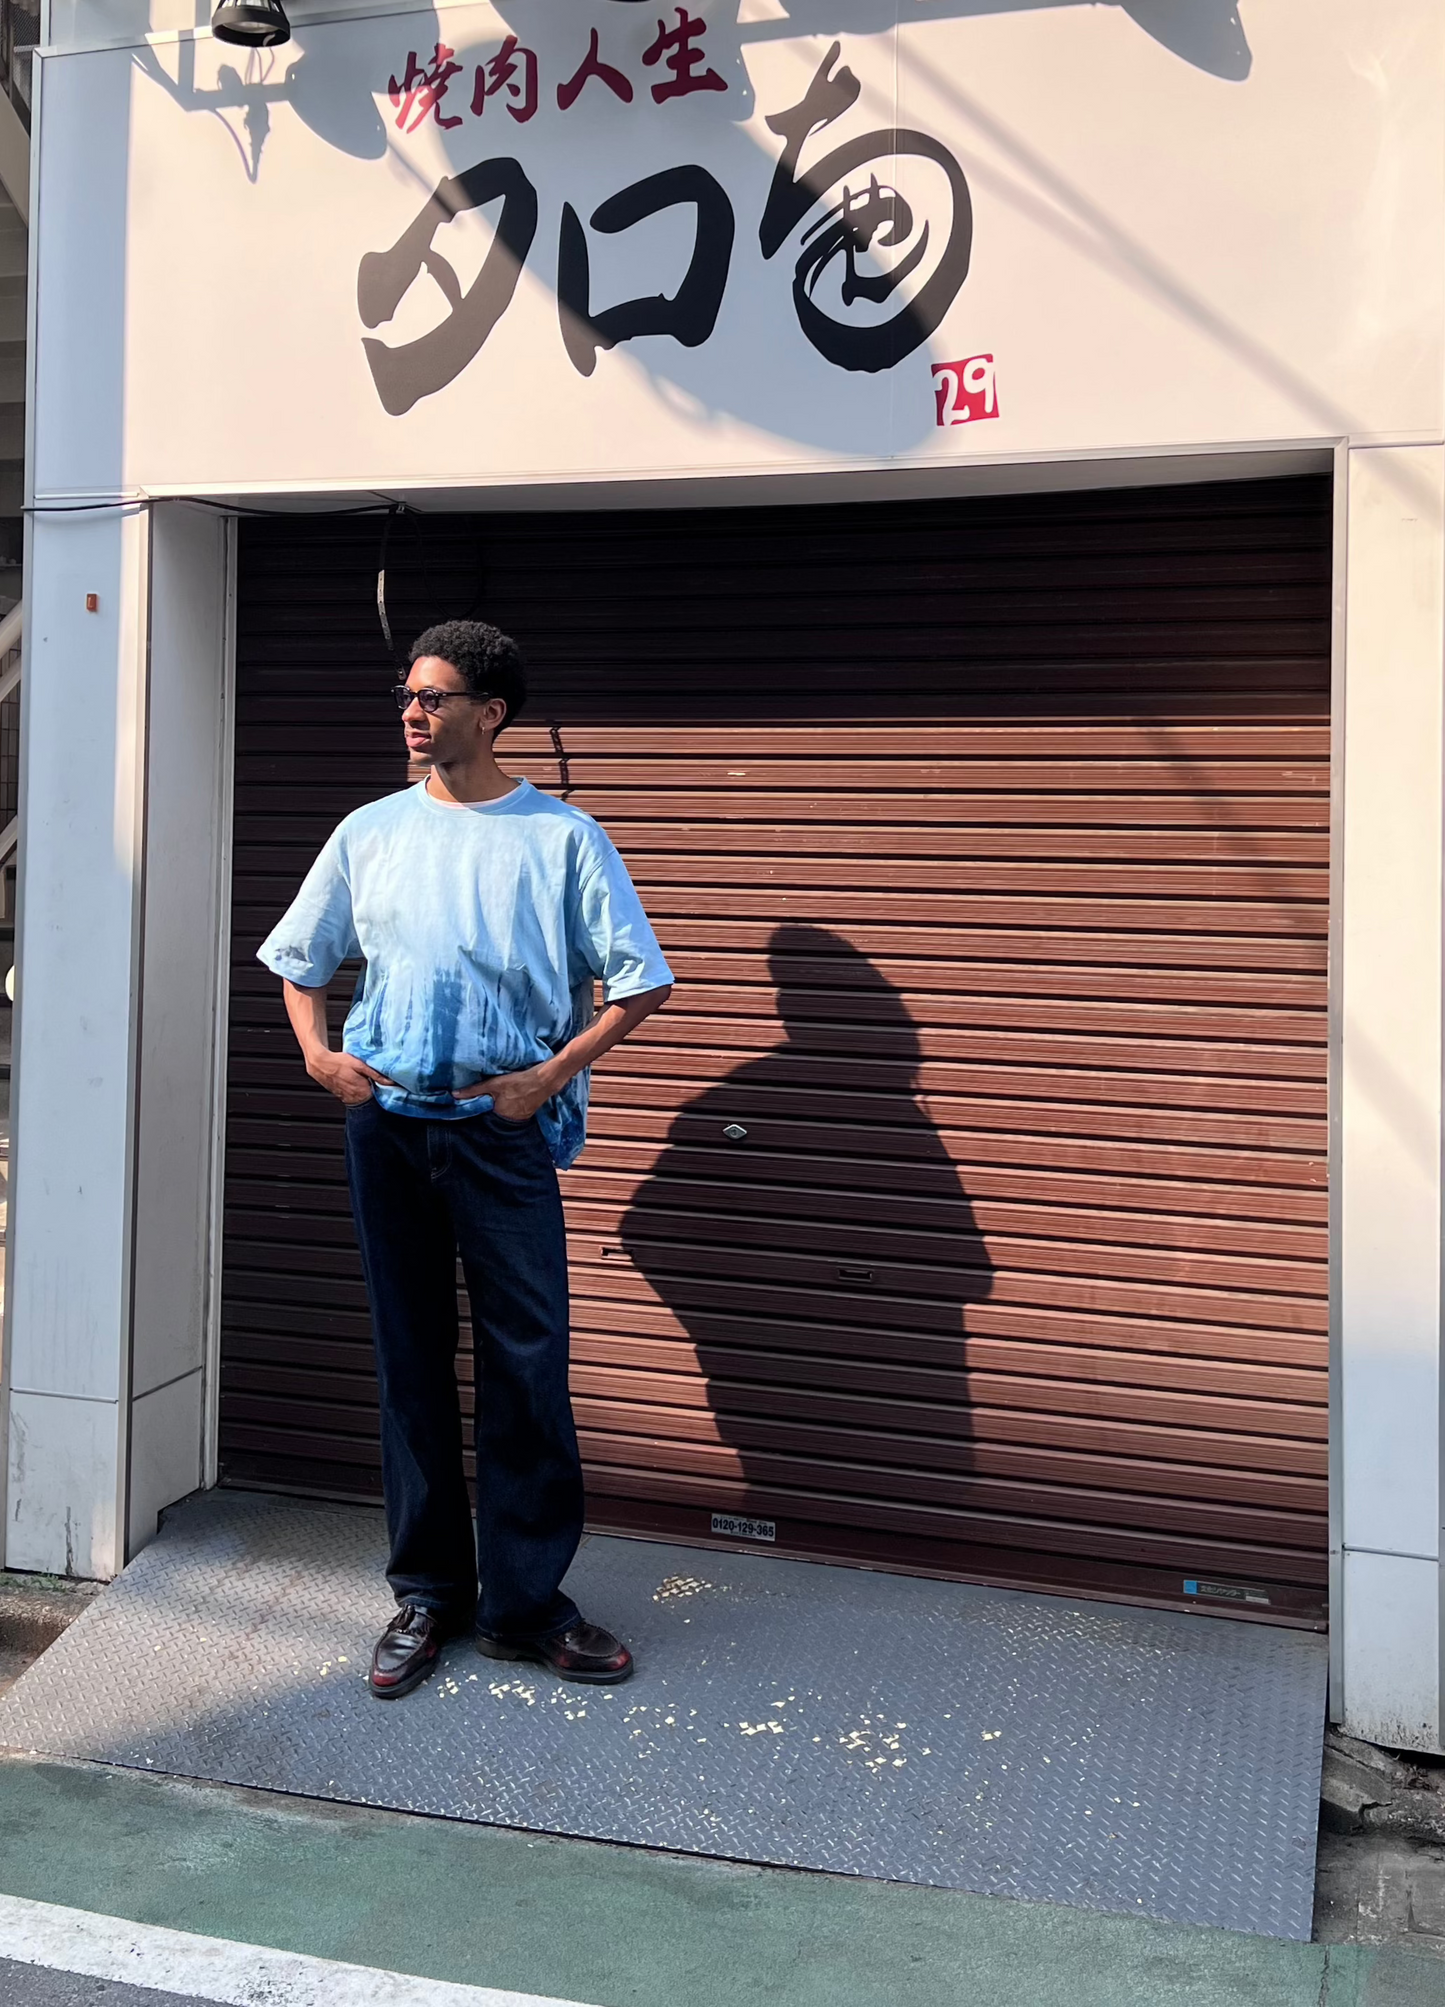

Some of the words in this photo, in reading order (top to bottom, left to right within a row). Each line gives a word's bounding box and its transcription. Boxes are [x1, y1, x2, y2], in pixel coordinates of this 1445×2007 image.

[388, 7, 728, 133] 焼肉人生
[934, 357, 997, 425] 29
[712, 1517, 774, 1537] 0120-129-365
